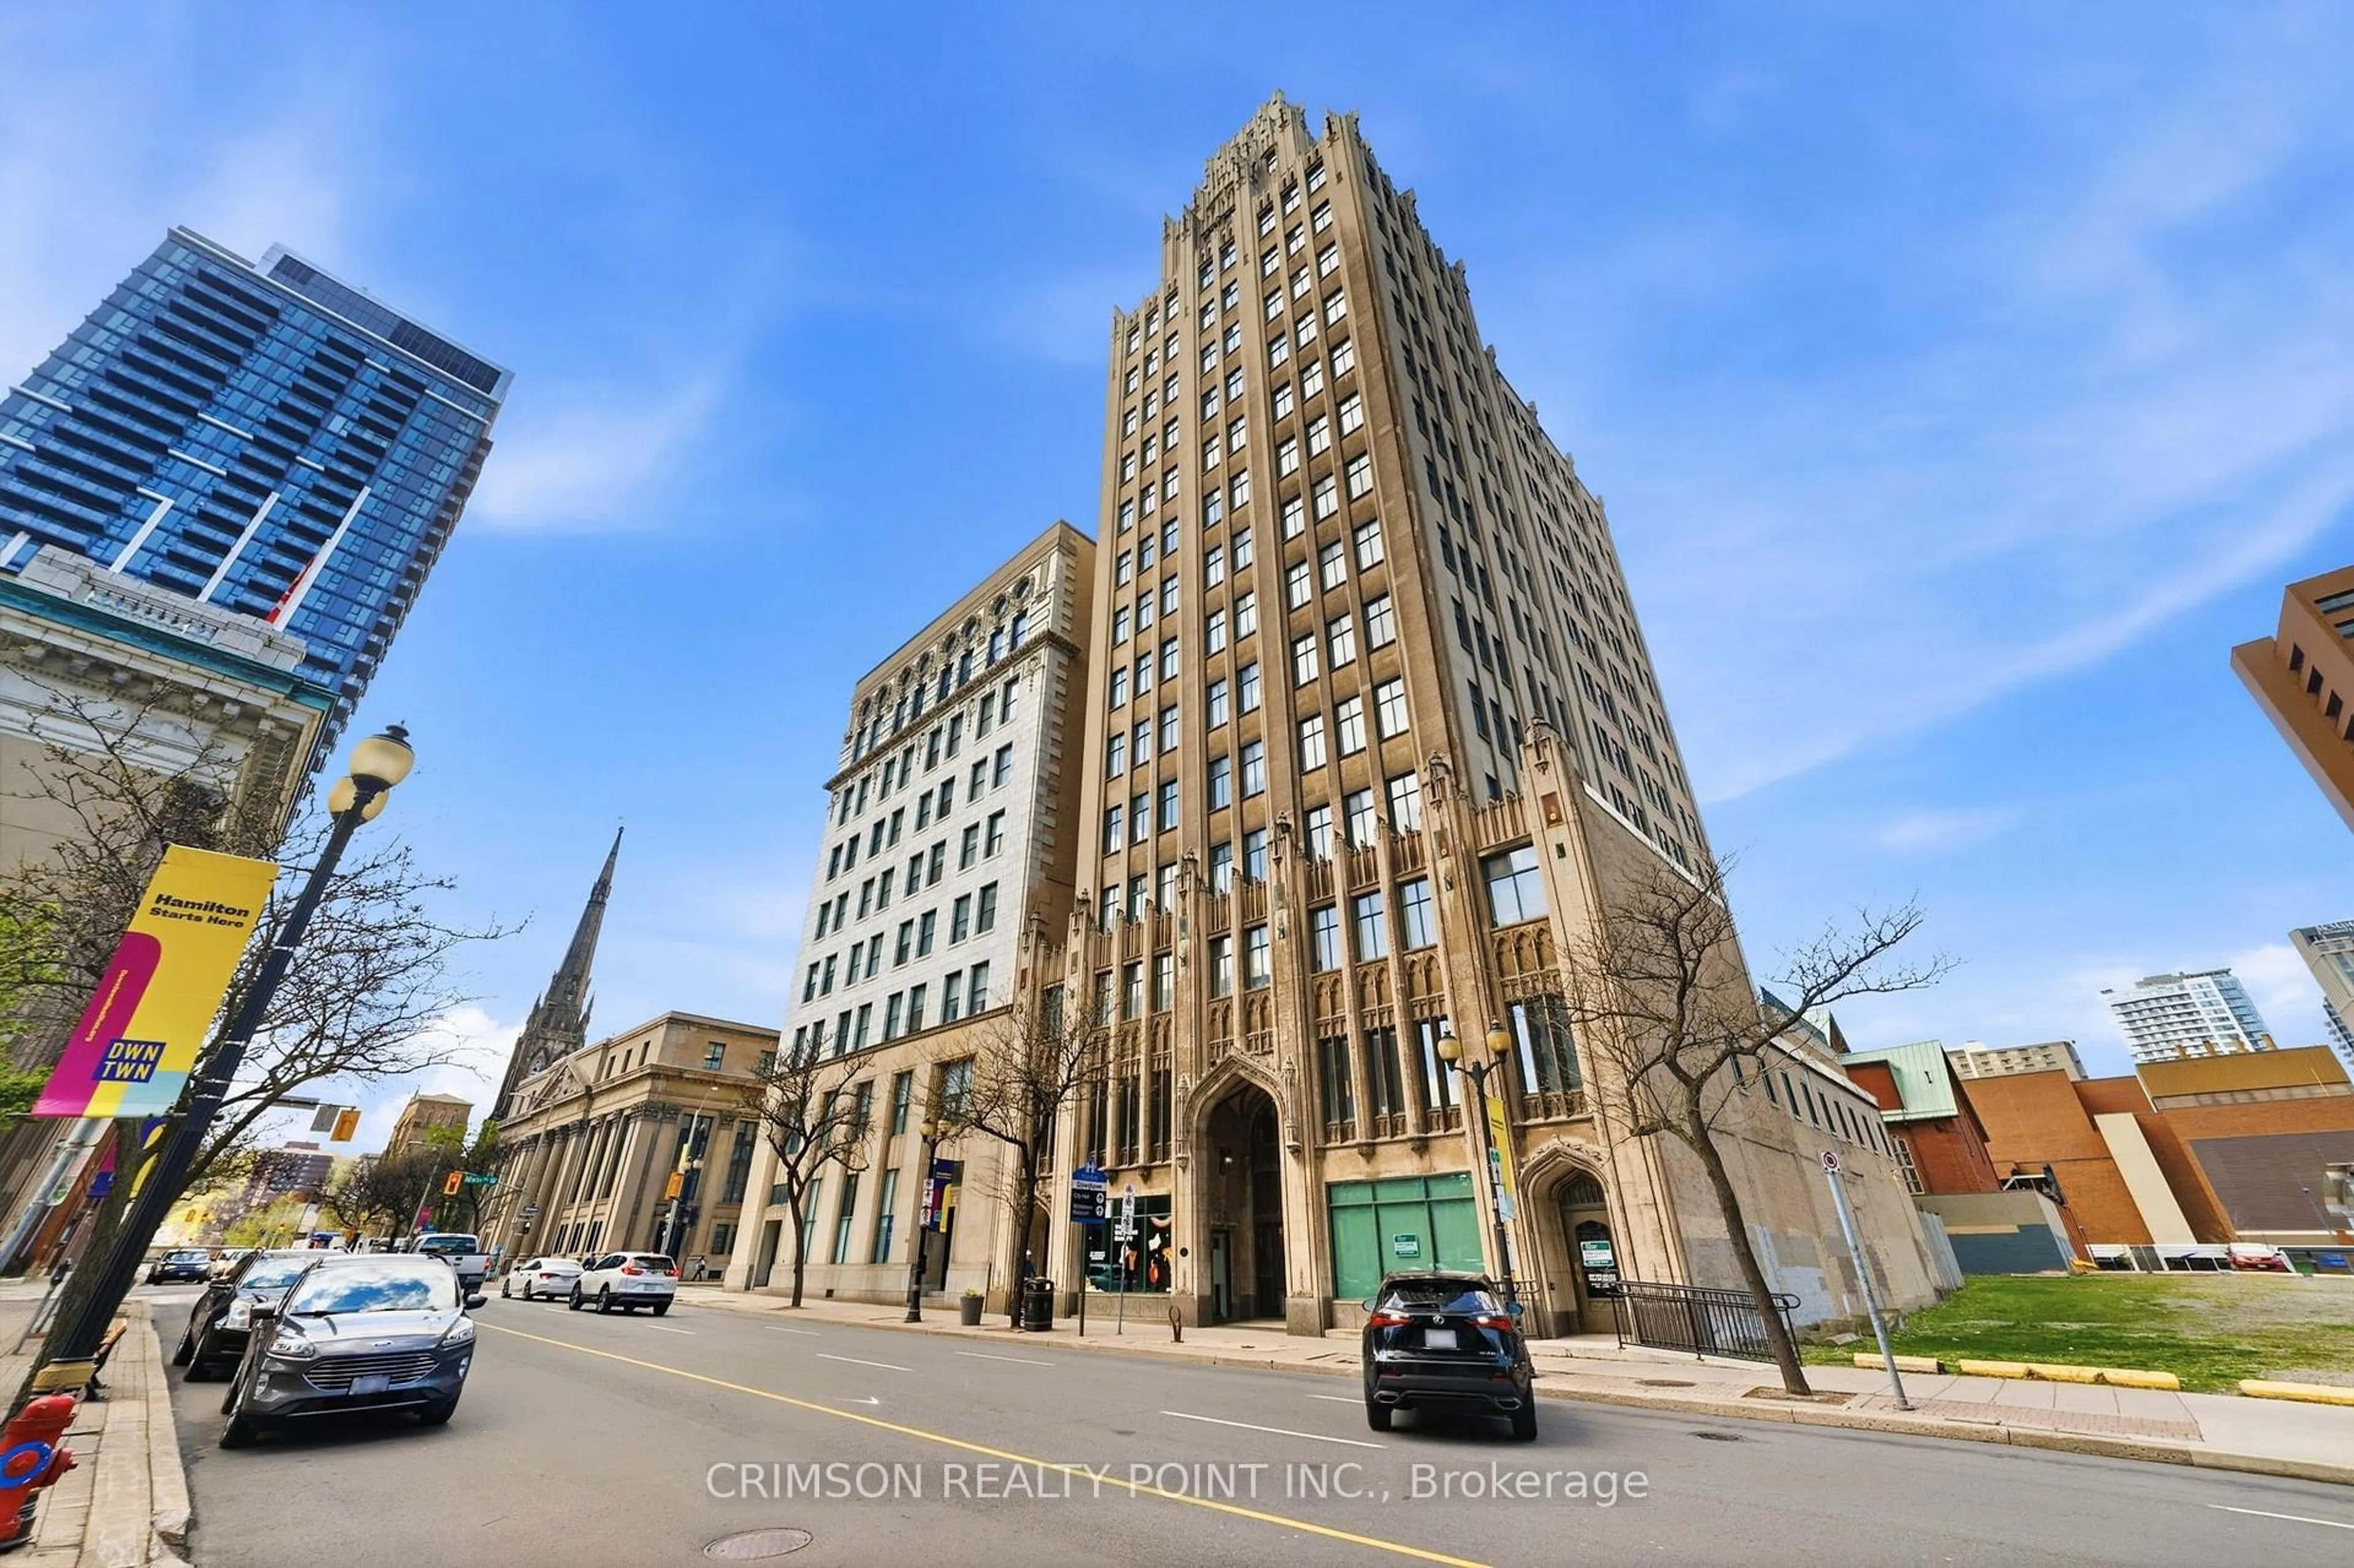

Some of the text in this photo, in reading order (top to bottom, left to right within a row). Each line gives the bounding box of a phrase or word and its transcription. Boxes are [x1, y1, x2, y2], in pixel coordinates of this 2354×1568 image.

[154, 894, 249, 917] Hamilton
[149, 907, 244, 928] Starts Here
[108, 1042, 160, 1061] DWN
[102, 1061, 151, 1079] TWN
